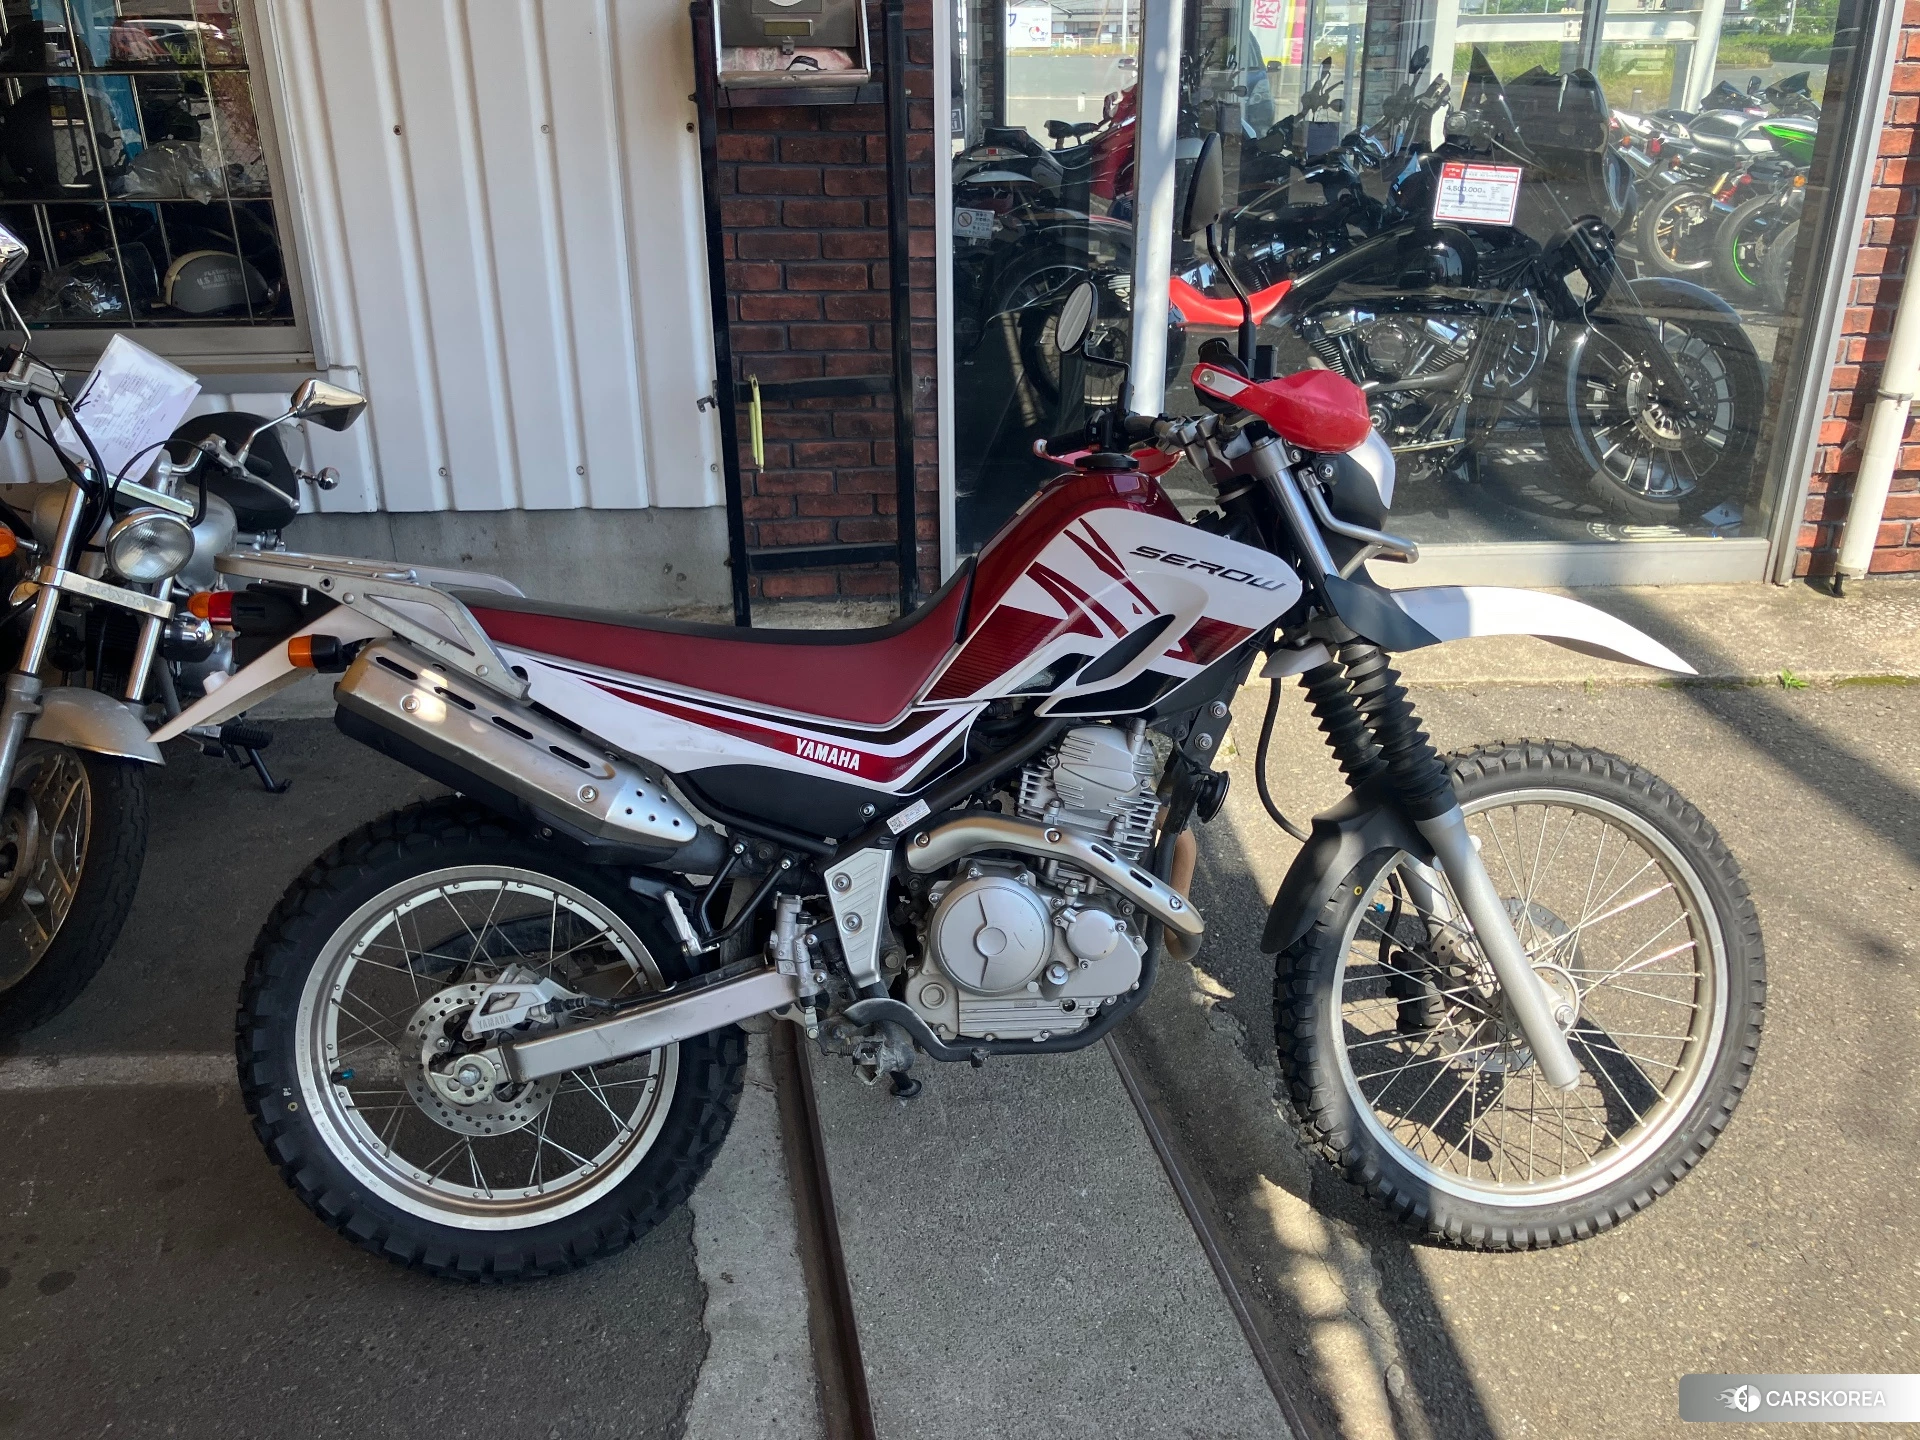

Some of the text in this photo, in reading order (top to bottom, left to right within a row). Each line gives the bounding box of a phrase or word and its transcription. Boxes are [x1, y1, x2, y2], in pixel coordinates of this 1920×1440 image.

[1129, 545, 1286, 591] SEROW
[85, 583, 148, 607] HONDA
[796, 738, 860, 770] YAMAHA
[477, 1014, 511, 1029] YAMAHA
